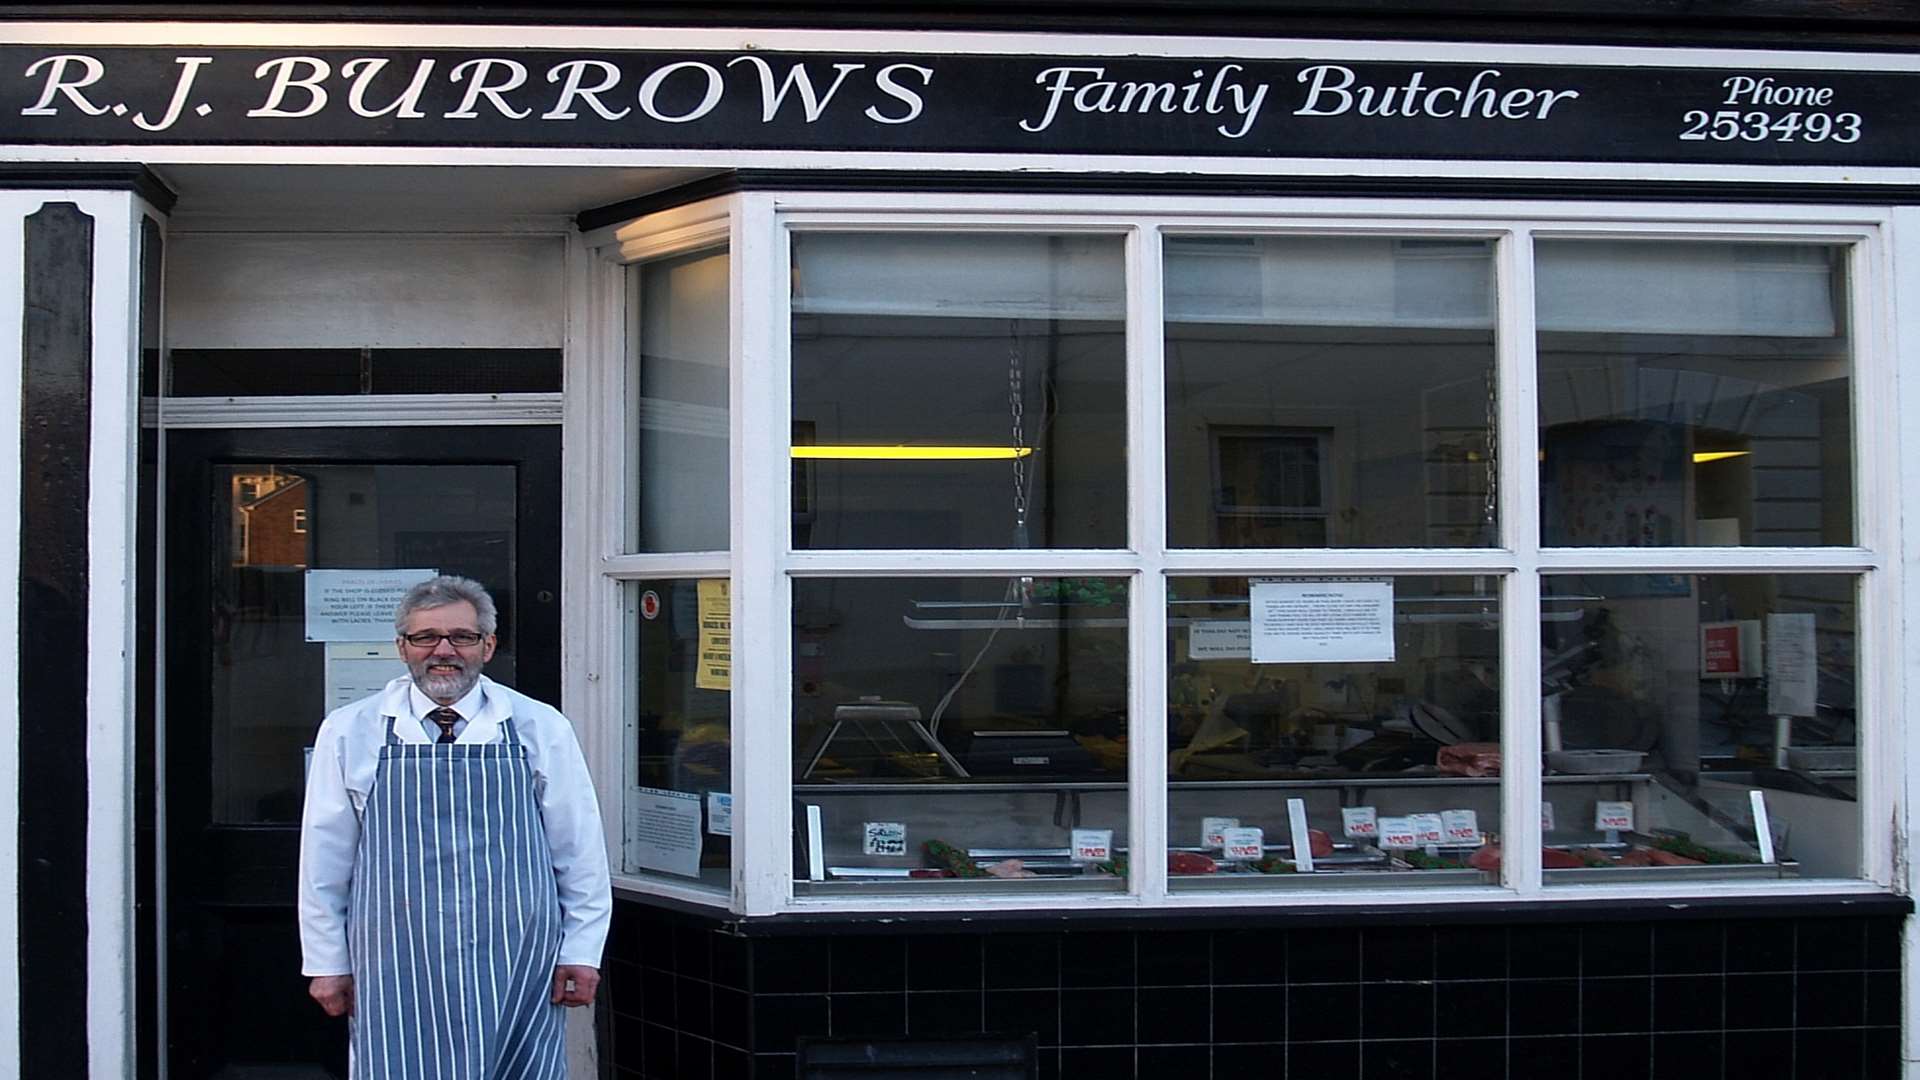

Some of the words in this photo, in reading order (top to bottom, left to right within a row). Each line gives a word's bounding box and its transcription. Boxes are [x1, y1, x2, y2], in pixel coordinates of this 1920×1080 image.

[247, 54, 934, 124] BURROWS
[1018, 62, 1269, 138] Family
[1293, 65, 1580, 119] Butcher
[1722, 75, 1834, 106] Phone
[1679, 110, 1863, 142] 253493
